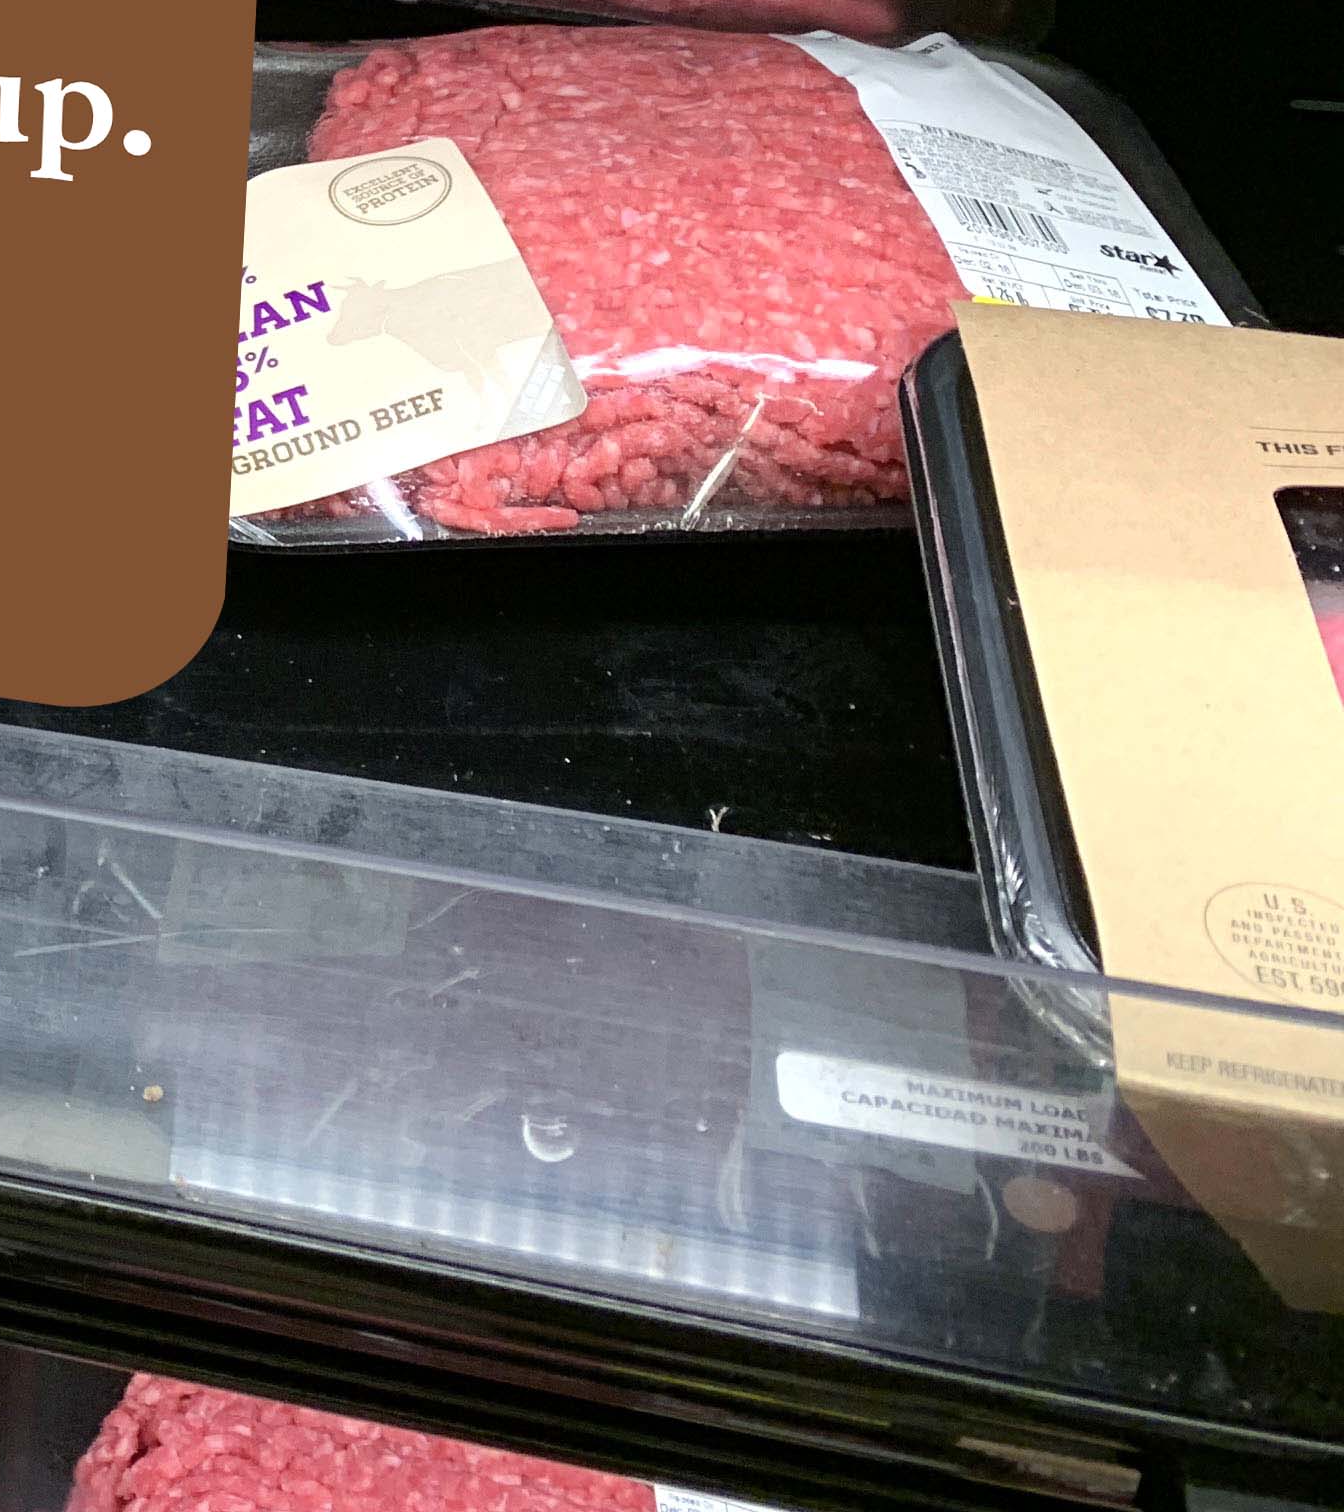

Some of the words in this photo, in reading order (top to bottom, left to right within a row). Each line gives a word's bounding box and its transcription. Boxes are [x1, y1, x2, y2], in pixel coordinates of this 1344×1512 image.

[356, 174, 440, 214] PROTEIN
[1100, 242, 1153, 267] star
[238, 281, 331, 343] AN
[231, 419, 361, 476] GROUND
[370, 388, 444, 432] BEEF
[1255, 440, 1319, 456] THIS
[1249, 949, 1344, 976] AGRICULTU
[906, 1079, 1023, 1112] MAXIMUM
[995, 1115, 1090, 1143] MAXIM
